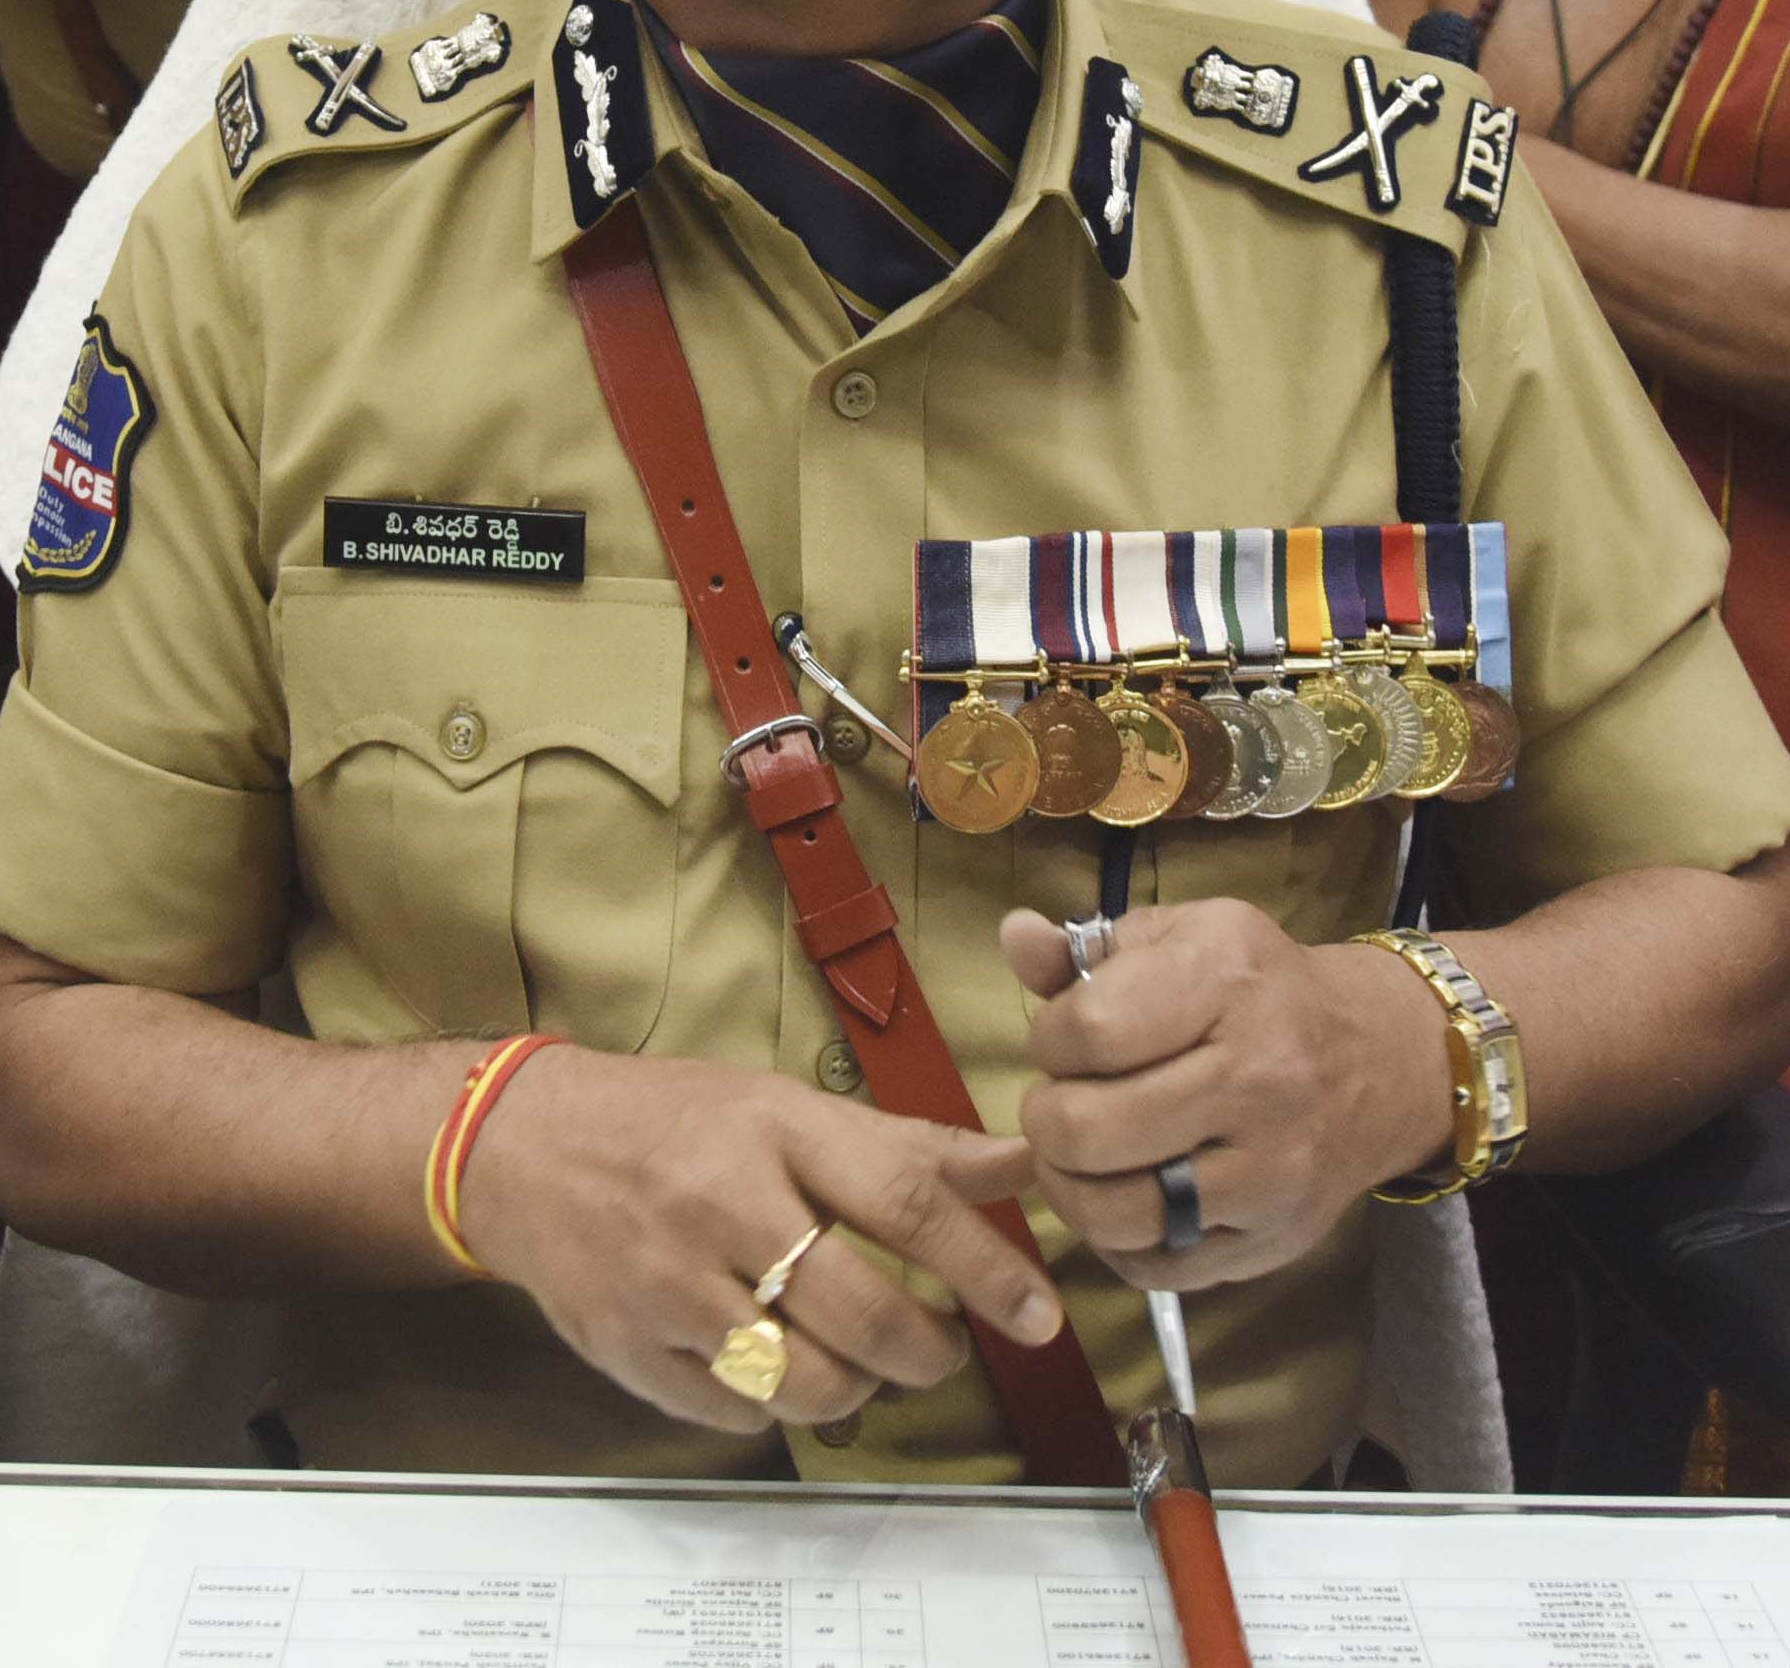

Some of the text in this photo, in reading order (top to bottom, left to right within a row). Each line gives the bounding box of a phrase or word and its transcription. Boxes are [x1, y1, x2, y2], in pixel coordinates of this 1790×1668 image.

[1457, 101, 1516, 219] IPS
[52, 423, 93, 462] ANGANA
[44, 443, 115, 510] LICE
[37, 502, 67, 528] onour
[38, 486, 65, 512] Duty
[32, 512, 74, 549] mpassion
[342, 540, 564, 572] B.SHIVADHAR REDDY
